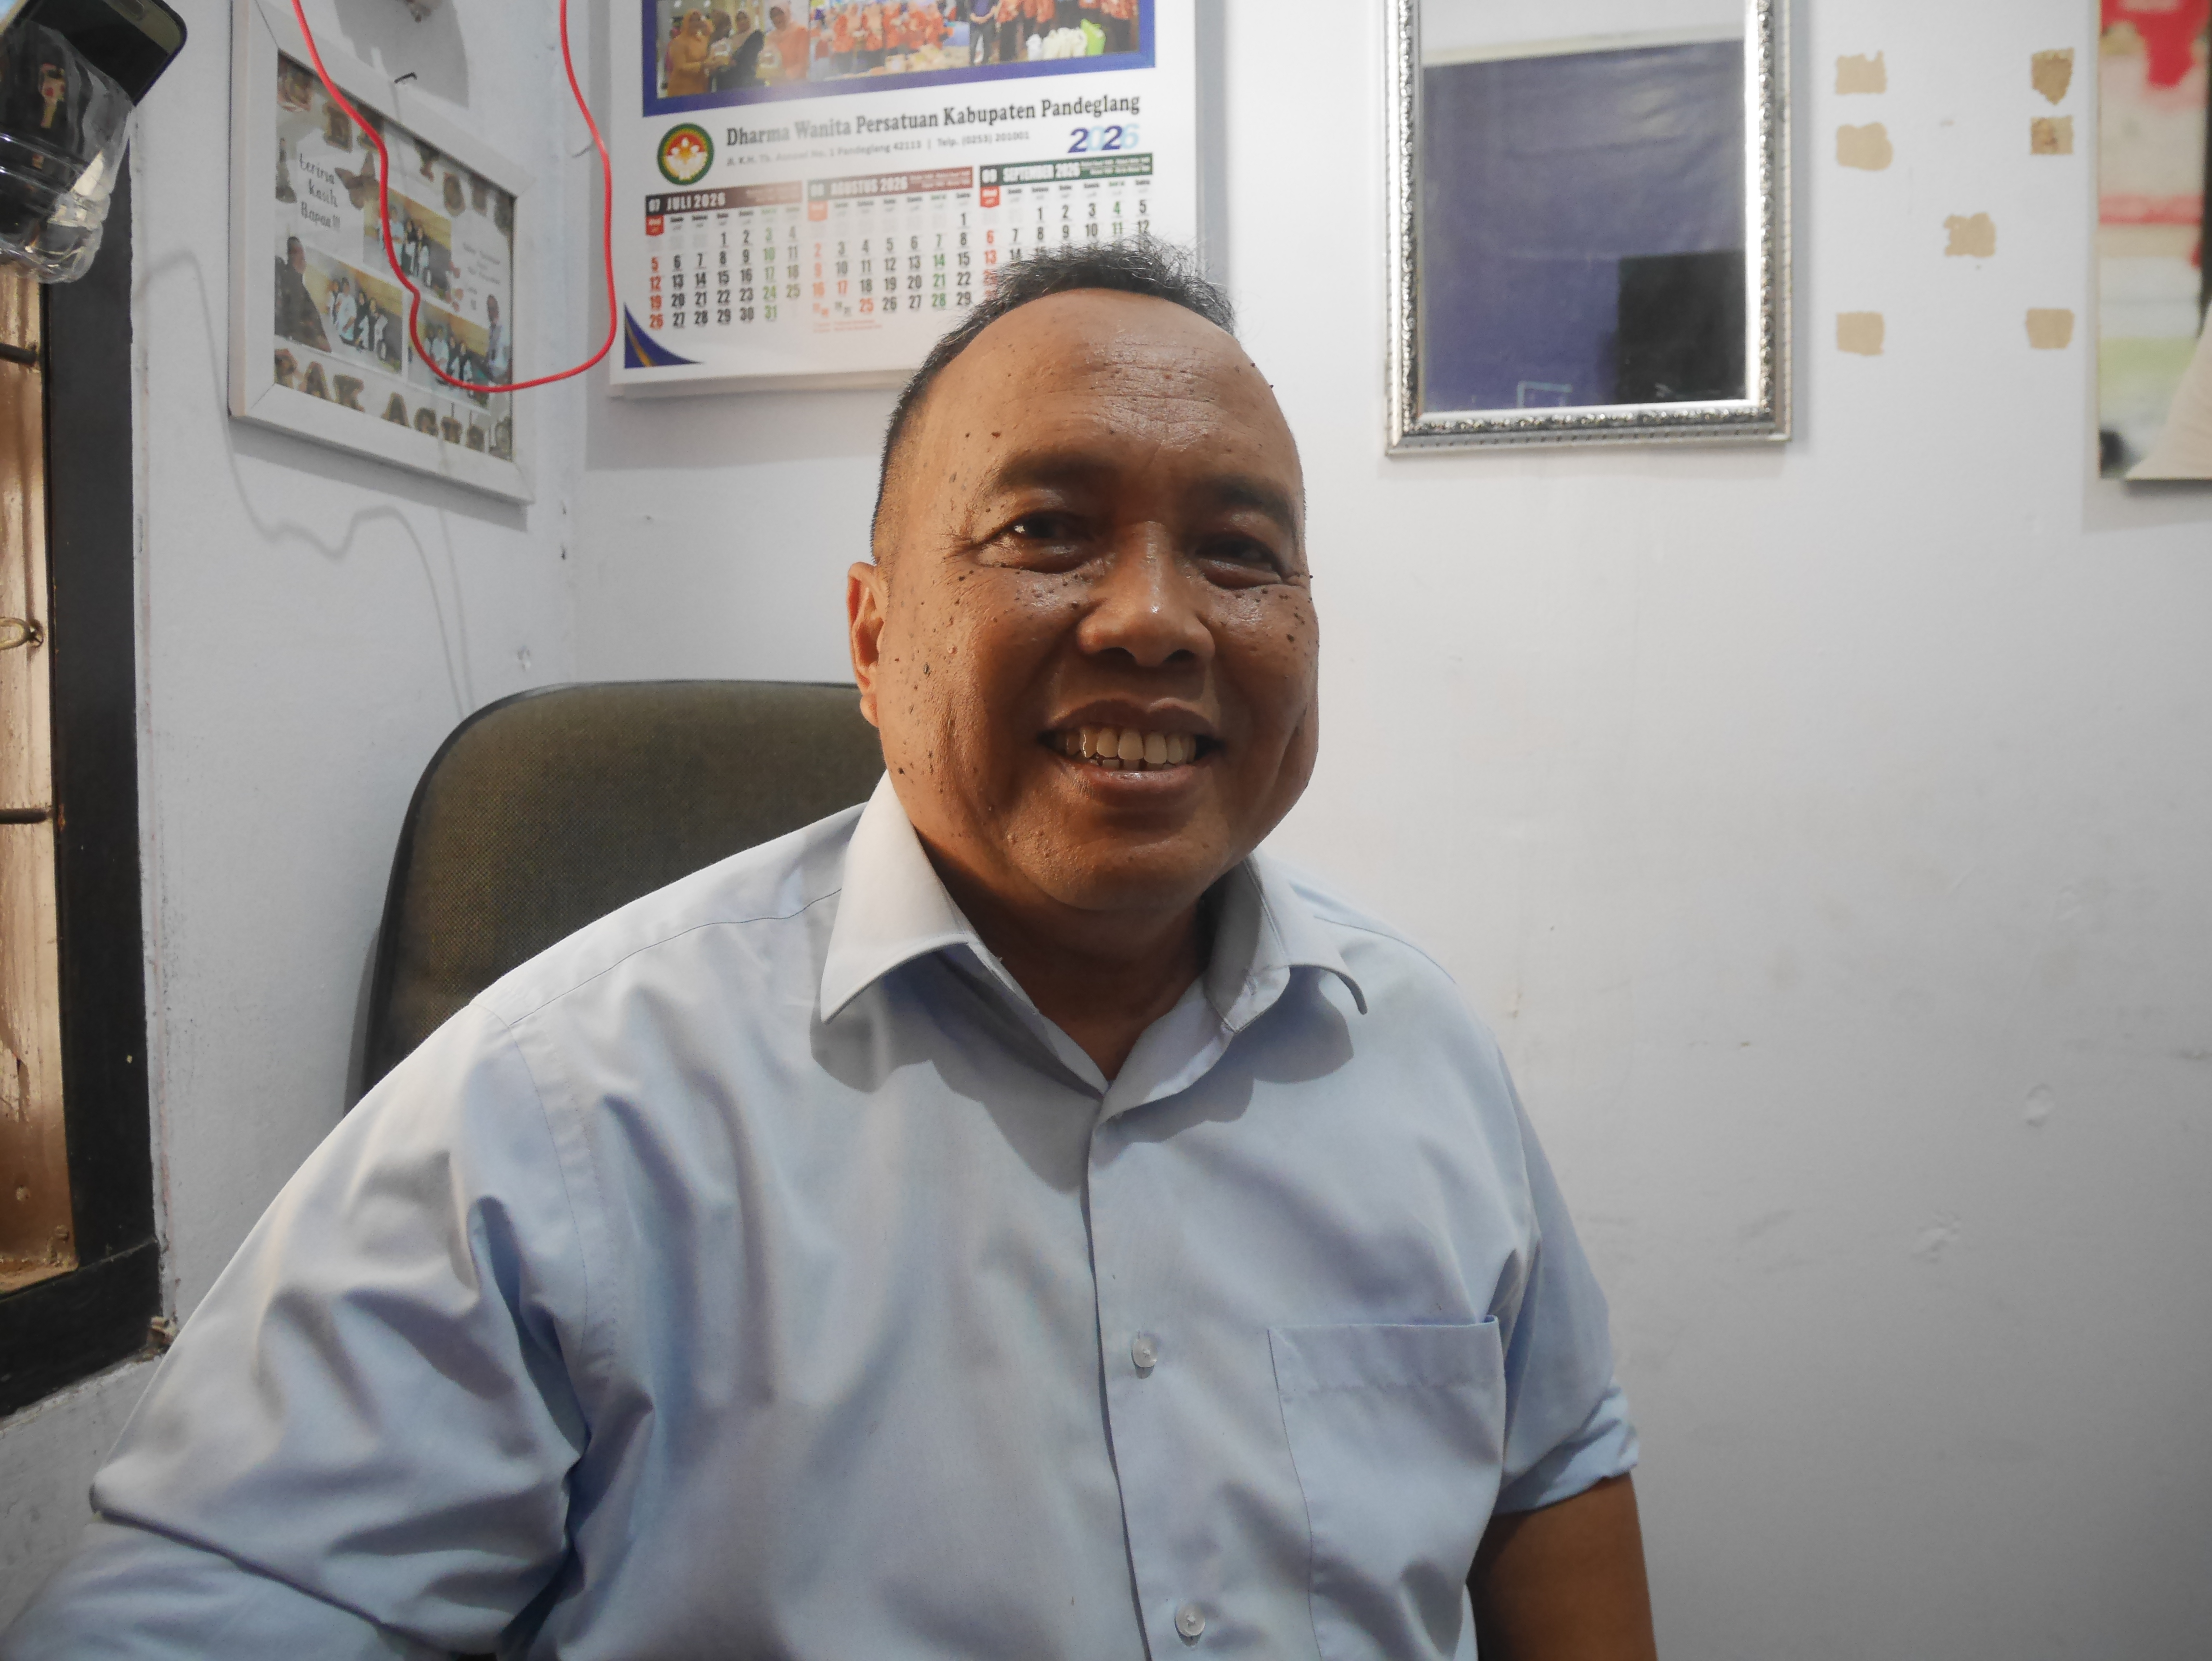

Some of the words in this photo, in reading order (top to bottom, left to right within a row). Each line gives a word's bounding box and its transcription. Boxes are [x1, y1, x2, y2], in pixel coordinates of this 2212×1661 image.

[727, 127, 789, 146] Dharma
[795, 119, 851, 139] Wanita
[856, 113, 938, 134] Persatuan
[944, 105, 1035, 126] Kabupaten
[1041, 95, 1140, 118] Pandeglang
[1067, 123, 1140, 153] 2026
[838, 143, 890, 155] Pandeglang
[1003, 164, 1054, 182] SEPTEMBER
[1055, 162, 1080, 178] 2026
[830, 178, 879, 196] AGUSTUS
[881, 176, 908, 192] 2026
[667, 195, 692, 211] JULI
[694, 192, 725, 209] 2026
[1038, 206, 1042, 220] 1
[1063, 205, 1069, 218] 2
[1089, 203, 1096, 217] 3
[1114, 201, 1120, 214] 4
[1140, 199, 1146, 213] 5
[961, 212, 966, 225] 1
[721, 232, 726, 245] 1
[744, 230, 750, 244] 2
[987, 230, 993, 244] 6
[1013, 228, 1019, 241] 7
[1038, 226, 1043, 240] 8
[1063, 225, 1069, 238] 9
[1085, 223, 1098, 237] 10
[1112, 222, 1123, 235] 11
[1137, 220, 1149, 233] 12
[815, 243, 821, 257] 2
[838, 241, 845, 255] 3
[862, 239, 869, 253] 4
[887, 238, 894, 251] 5
[911, 236, 918, 249] 6
[936, 234, 941, 247] 7
[961, 233, 967, 245] 8
[652, 257, 658, 272] 5
[674, 254, 681, 268] 6
[698, 253, 703, 267] 7
[720, 250, 726, 264] 8
[743, 249, 750, 263] 9
[788, 246, 798, 259] 11
[861, 260, 870, 272] 11
[884, 257, 896, 270] 12
[908, 256, 921, 269] 13
[934, 253, 945, 266] 14
[958, 252, 970, 265] 15
[985, 250, 996, 264] 13
[650, 276, 661, 291] 12
[672, 274, 684, 289] 13
[696, 272, 706, 286] 14
[718, 270, 729, 284] 15
[741, 268, 752, 282] 16
[765, 266, 775, 280] 17
[838, 280, 848, 294] 17
[860, 278, 872, 292] 18
[884, 277, 896, 290] 19
[908, 275, 922, 289] 20
[933, 273, 945, 287] 21
[957, 272, 971, 286] 22
[672, 293, 685, 307] 20
[696, 291, 707, 305] 21
[717, 290, 730, 304] 22
[740, 288, 753, 302] 23
[859, 297, 874, 313] 25
[883, 296, 897, 311] 26
[909, 294, 922, 309] 27
[932, 293, 946, 307] 28
[957, 291, 971, 305] 29
[649, 314, 663, 329] 26
[673, 312, 685, 327] 27
[695, 310, 708, 324] 28
[717, 309, 731, 323] 29
[740, 306, 754, 320] 30
[764, 305, 777, 318] 31
